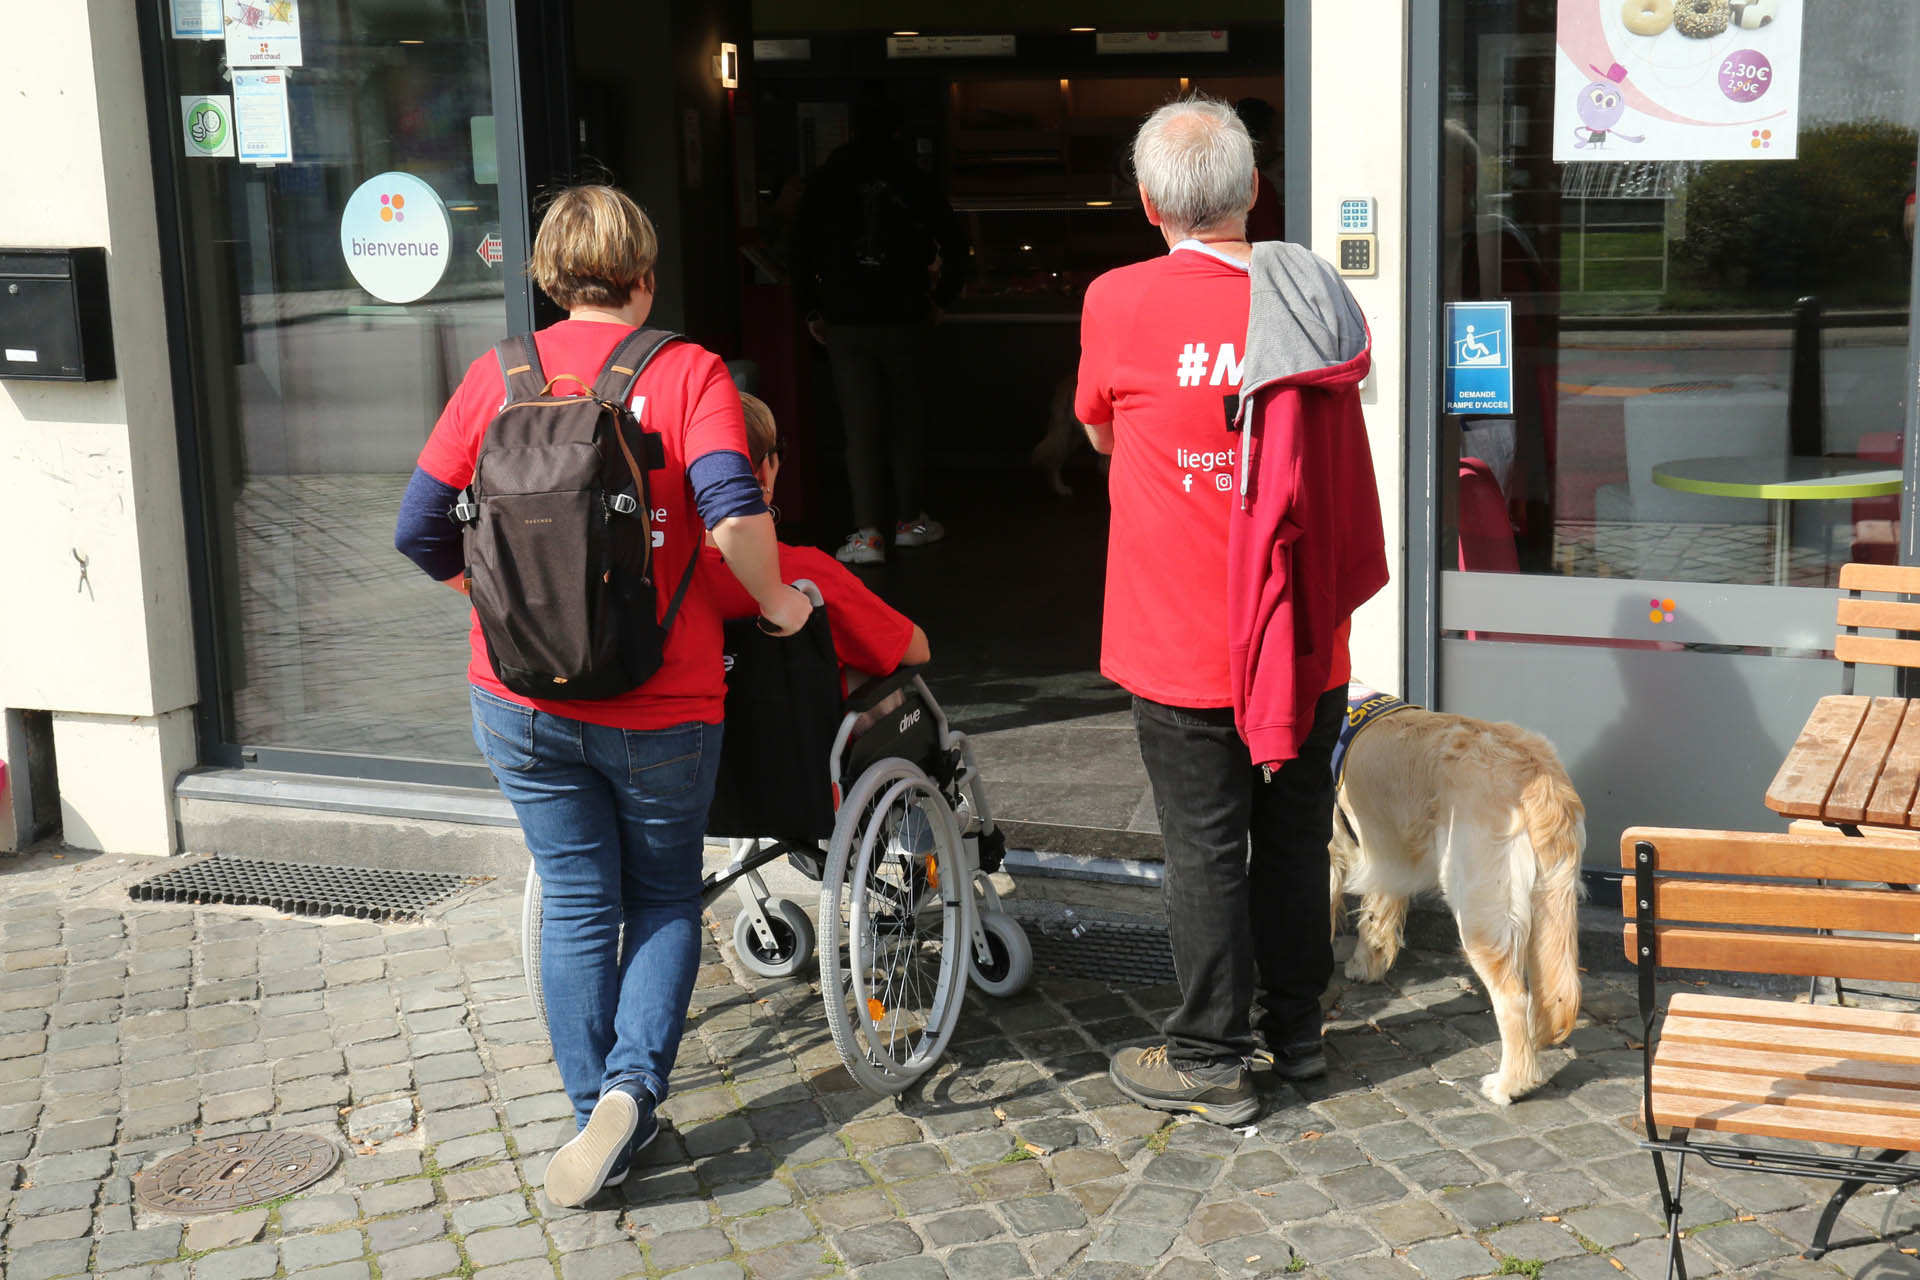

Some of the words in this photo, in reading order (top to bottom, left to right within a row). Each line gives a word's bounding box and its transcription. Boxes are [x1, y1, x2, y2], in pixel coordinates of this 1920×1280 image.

[1723, 61, 1770, 80] 2,30€
[352, 238, 439, 256] bienvenue
[1447, 401, 1473, 409] RAMPE
[1475, 400, 1508, 409] D'ACCÈS
[900, 709, 920, 733] drive
